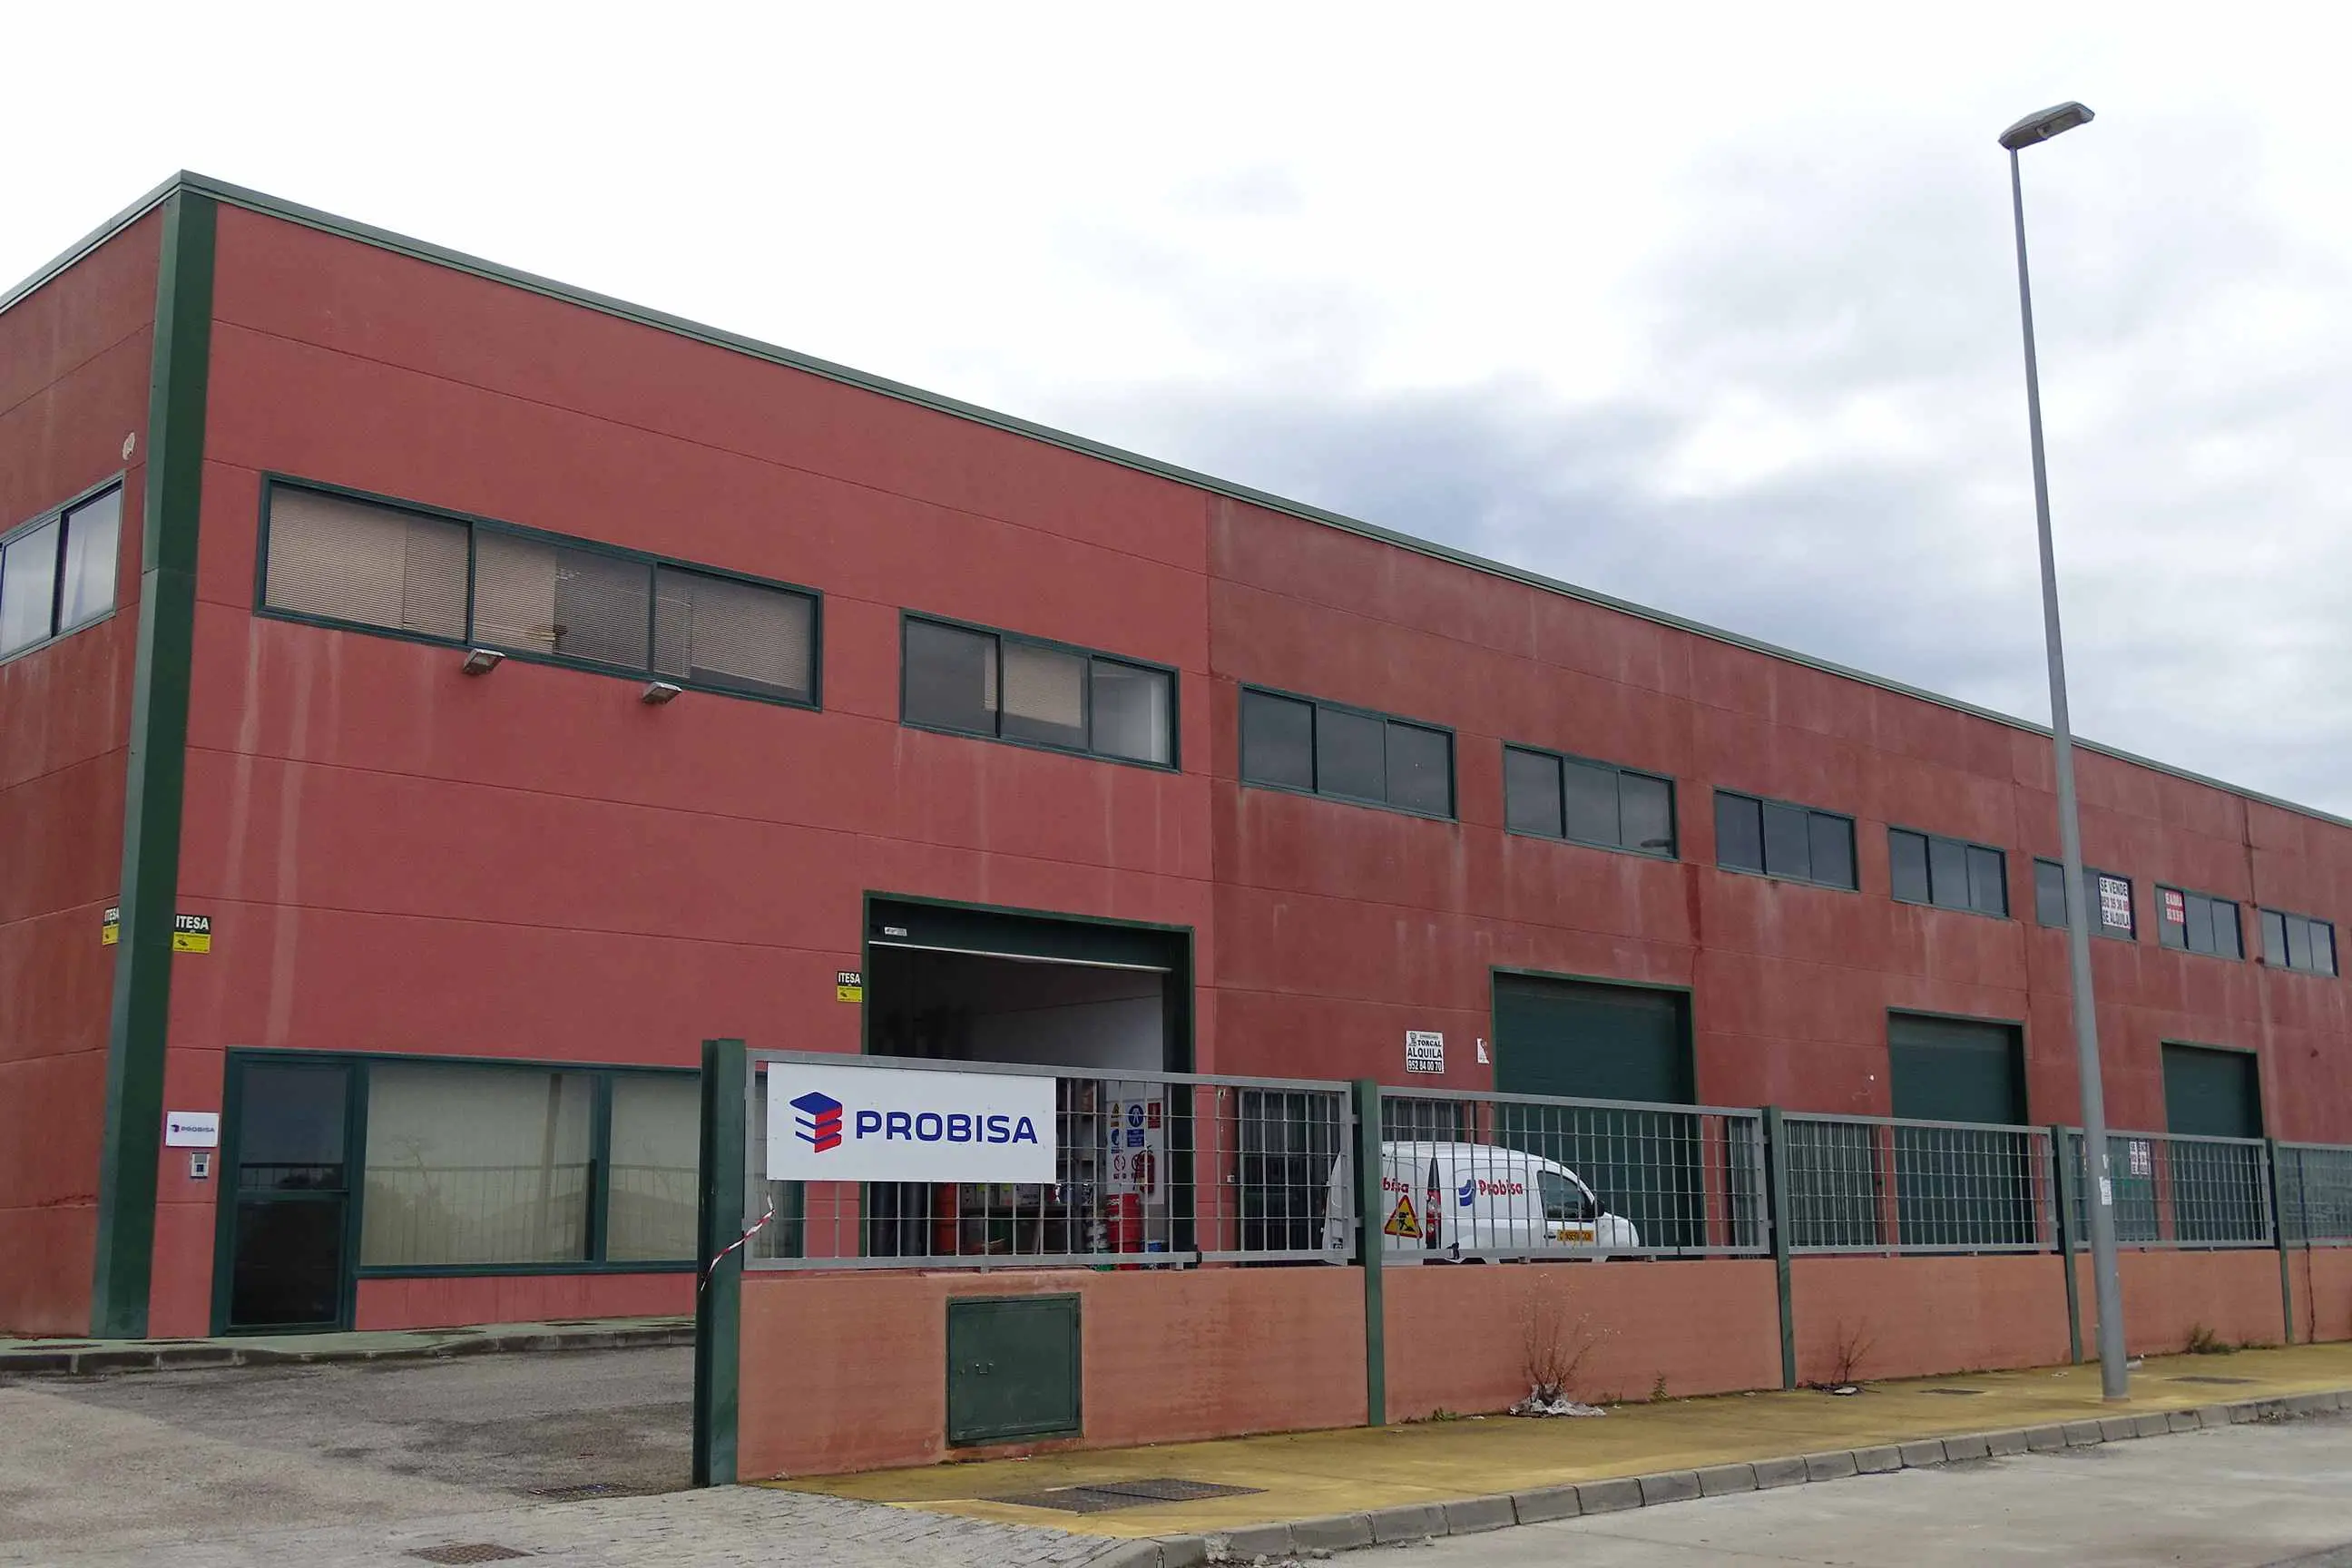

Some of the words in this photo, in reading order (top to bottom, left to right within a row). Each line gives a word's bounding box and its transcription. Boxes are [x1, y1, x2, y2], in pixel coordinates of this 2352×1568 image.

[176, 915, 210, 930] ITESA
[838, 972, 861, 984] ITESA
[1407, 1047, 1443, 1059] ALQUILA
[856, 1110, 1039, 1145] PROBISA
[1382, 1177, 1409, 1193] bisa
[1478, 1179, 1524, 1196] Probisa
